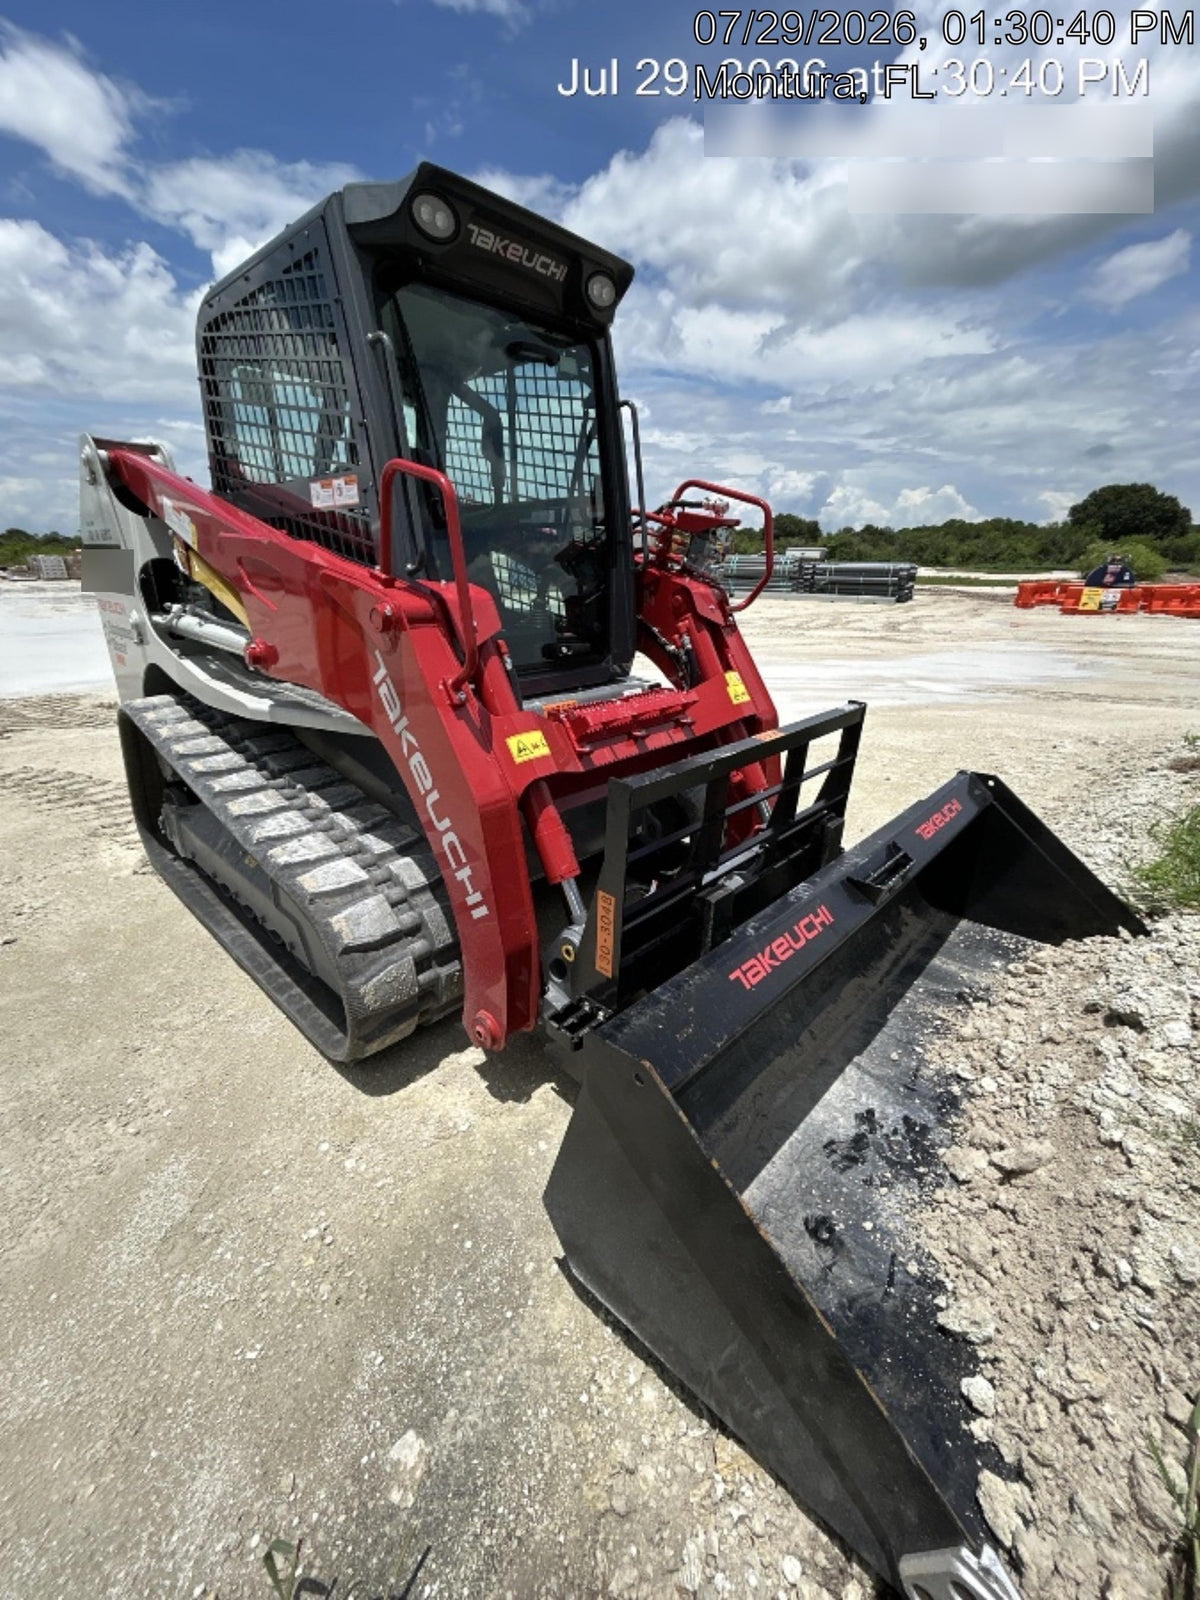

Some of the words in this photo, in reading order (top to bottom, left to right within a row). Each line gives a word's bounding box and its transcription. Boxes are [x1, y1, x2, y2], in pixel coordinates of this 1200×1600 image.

[466, 223, 568, 281] TAKEUCHI
[371, 649, 489, 919] TAKEUCHI
[915, 798, 963, 840] TAKEUCHI
[728, 904, 834, 991] TAKEUCHI
